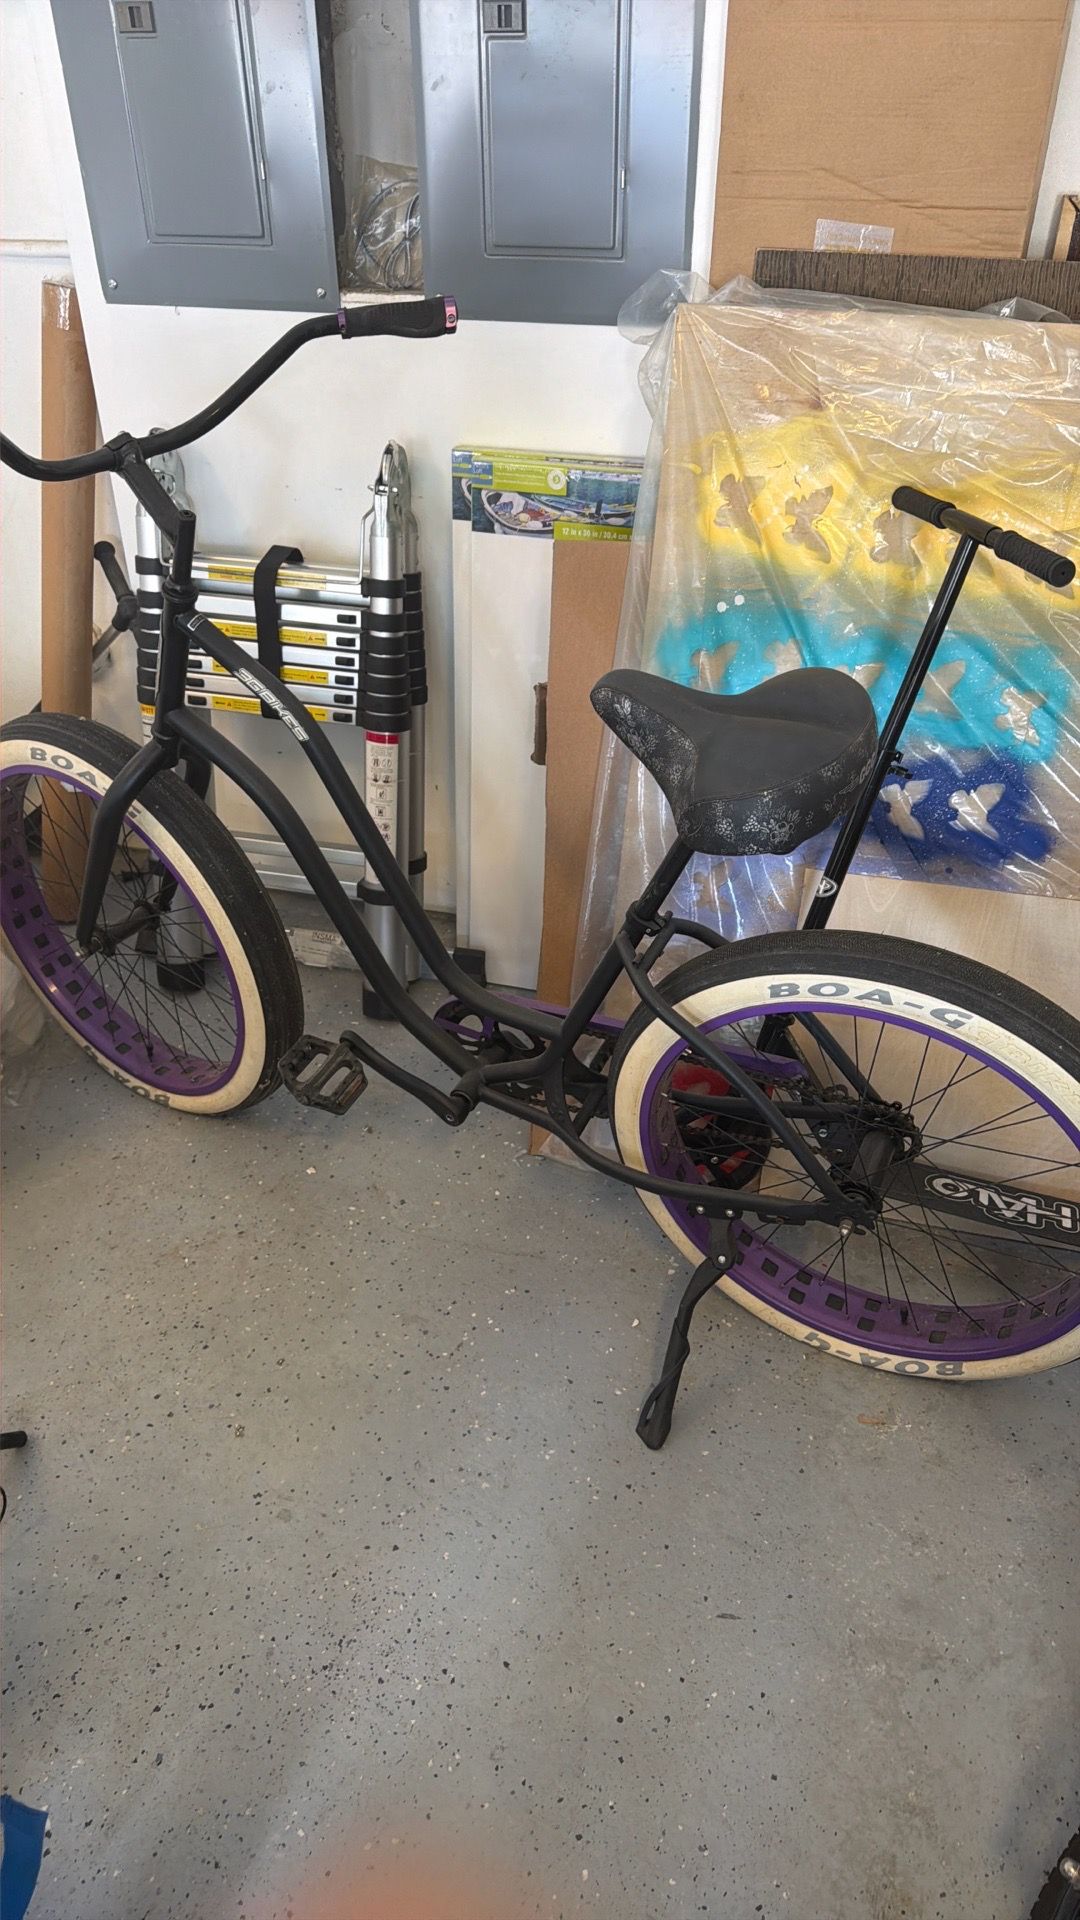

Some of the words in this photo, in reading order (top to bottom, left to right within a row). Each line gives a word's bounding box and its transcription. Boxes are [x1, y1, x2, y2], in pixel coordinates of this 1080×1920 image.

[766, 981, 975, 1031] BOA-G
[931, 1176, 1073, 1229] HALO
[803, 1331, 966, 1377] BOA-G
